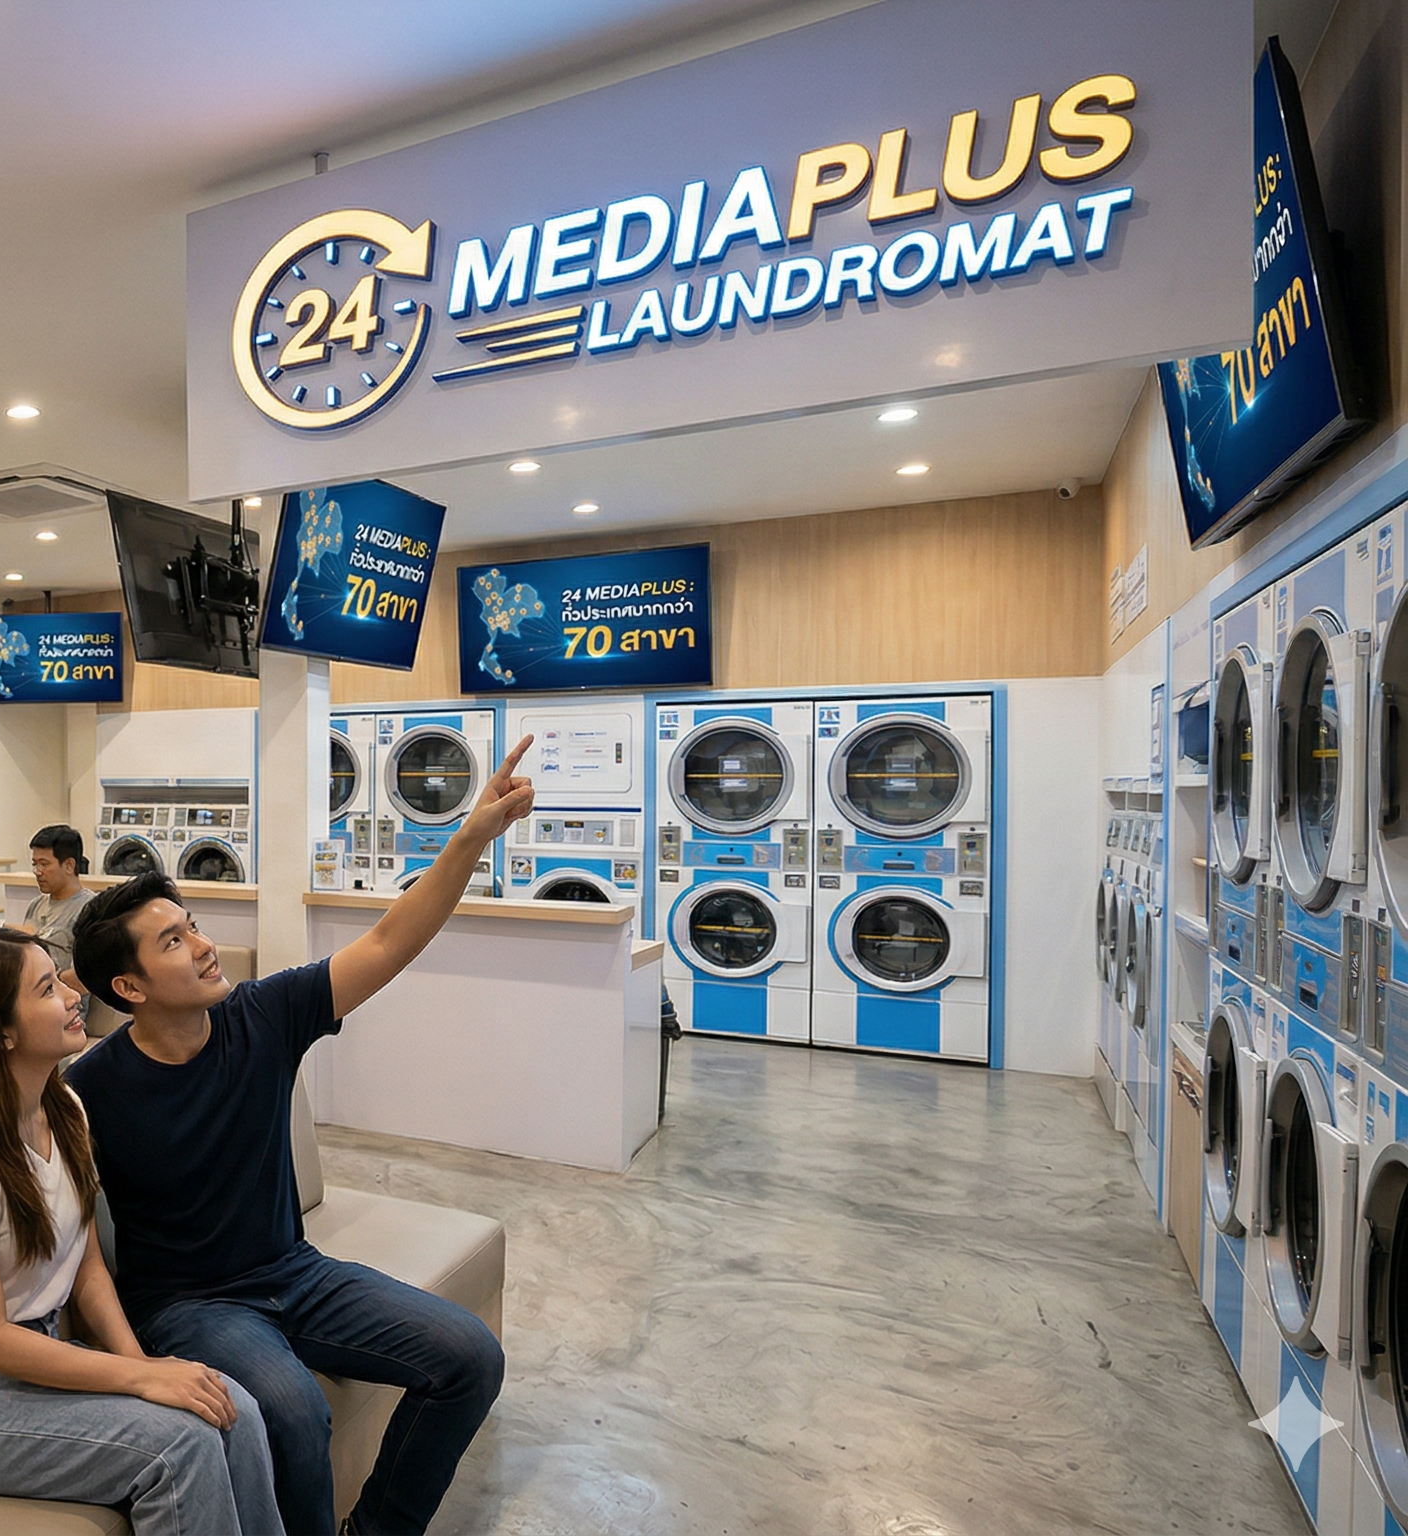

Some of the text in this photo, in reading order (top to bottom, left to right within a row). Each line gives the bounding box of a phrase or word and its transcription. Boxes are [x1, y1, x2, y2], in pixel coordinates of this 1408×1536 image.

[448, 73, 1137, 319] MEDIAPLUS
[586, 186, 1135, 355] LAUNDROMAT
[278, 273, 384, 371] 24
[1256, 276, 1311, 379] สาขา
[341, 573, 418, 624] 70 สาขา
[561, 587, 582, 604] 24
[39, 660, 114, 682] 70 สาขา
[563, 625, 696, 659] 70 สาขา
